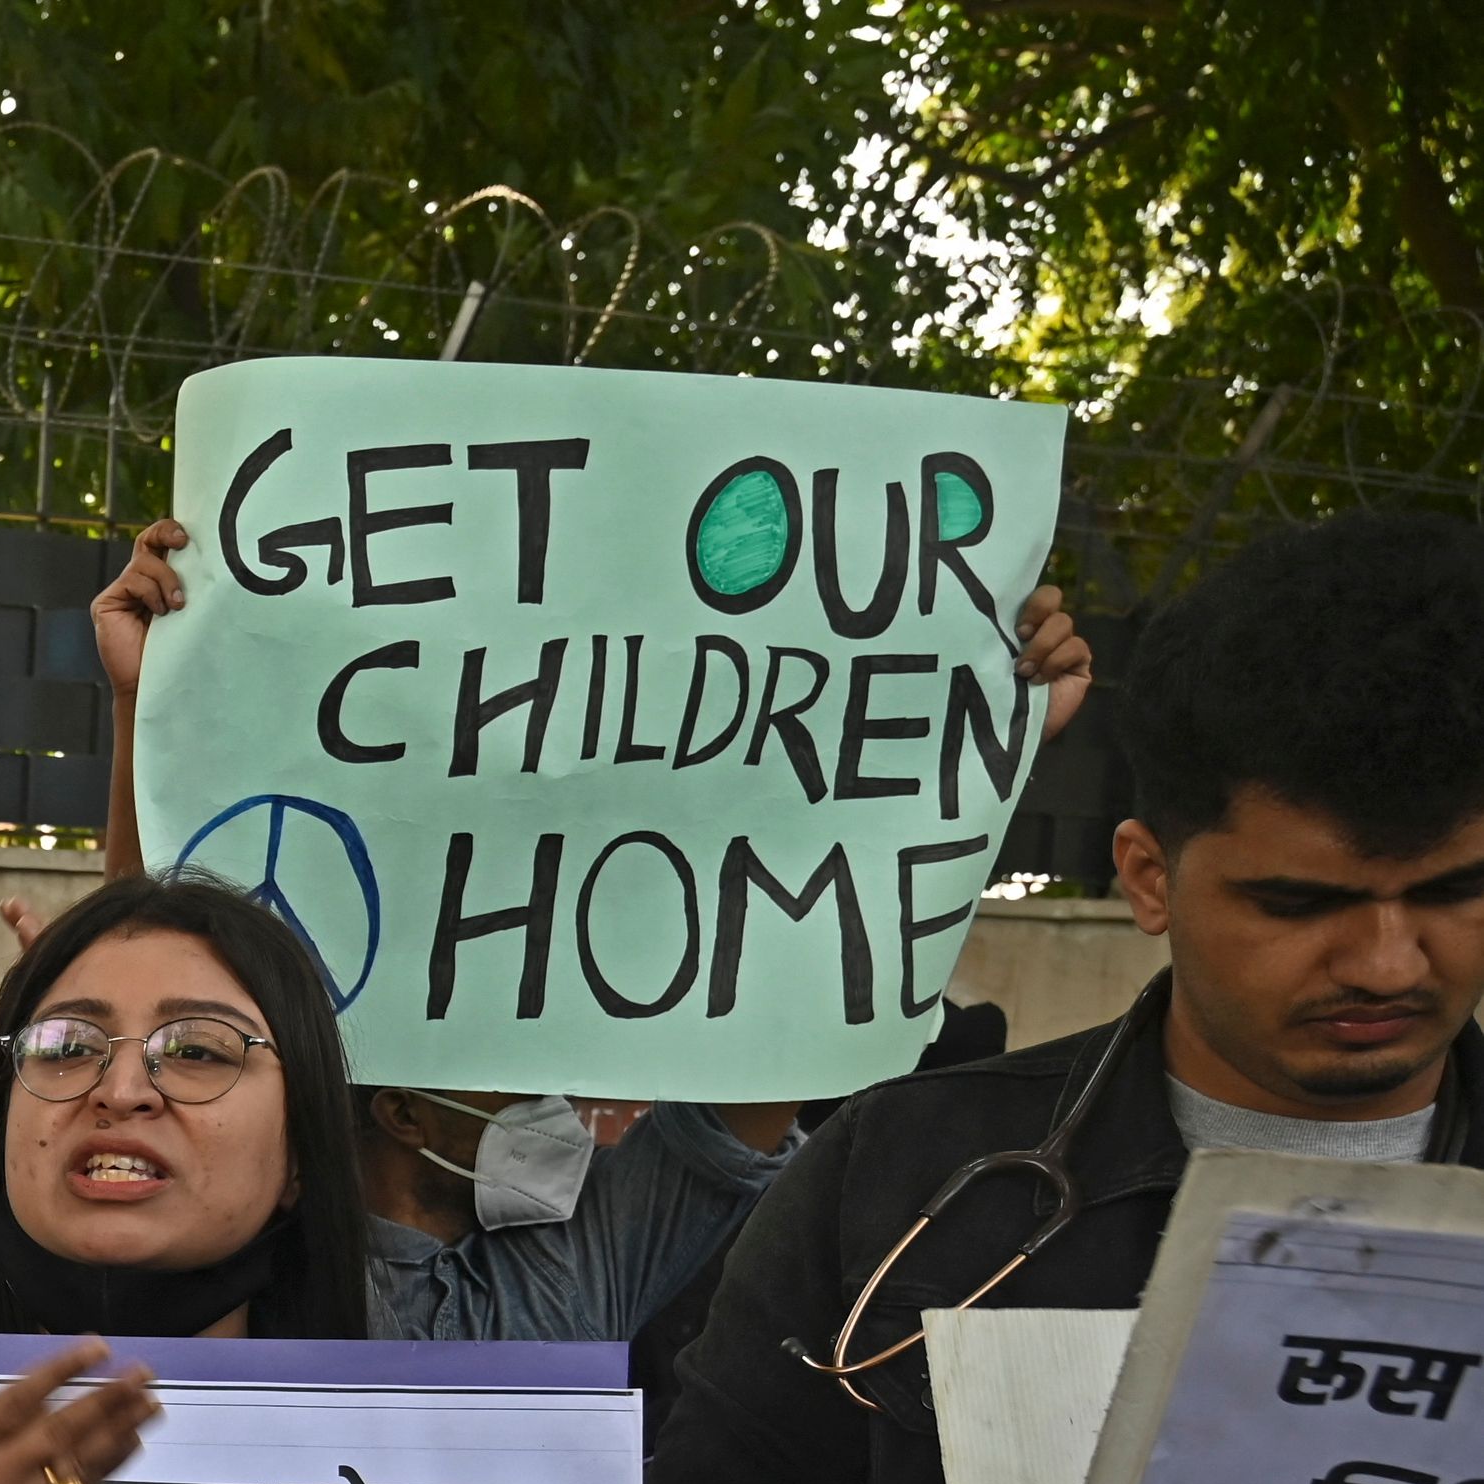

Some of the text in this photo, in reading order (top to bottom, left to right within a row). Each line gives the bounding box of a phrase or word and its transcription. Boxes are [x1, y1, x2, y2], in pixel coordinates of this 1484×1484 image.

[218, 427, 1020, 660] GET OUR
[316, 633, 1030, 822] CHILDREN
[425, 828, 990, 1024] HOME
[1276, 1333, 1483, 1422] रूस
